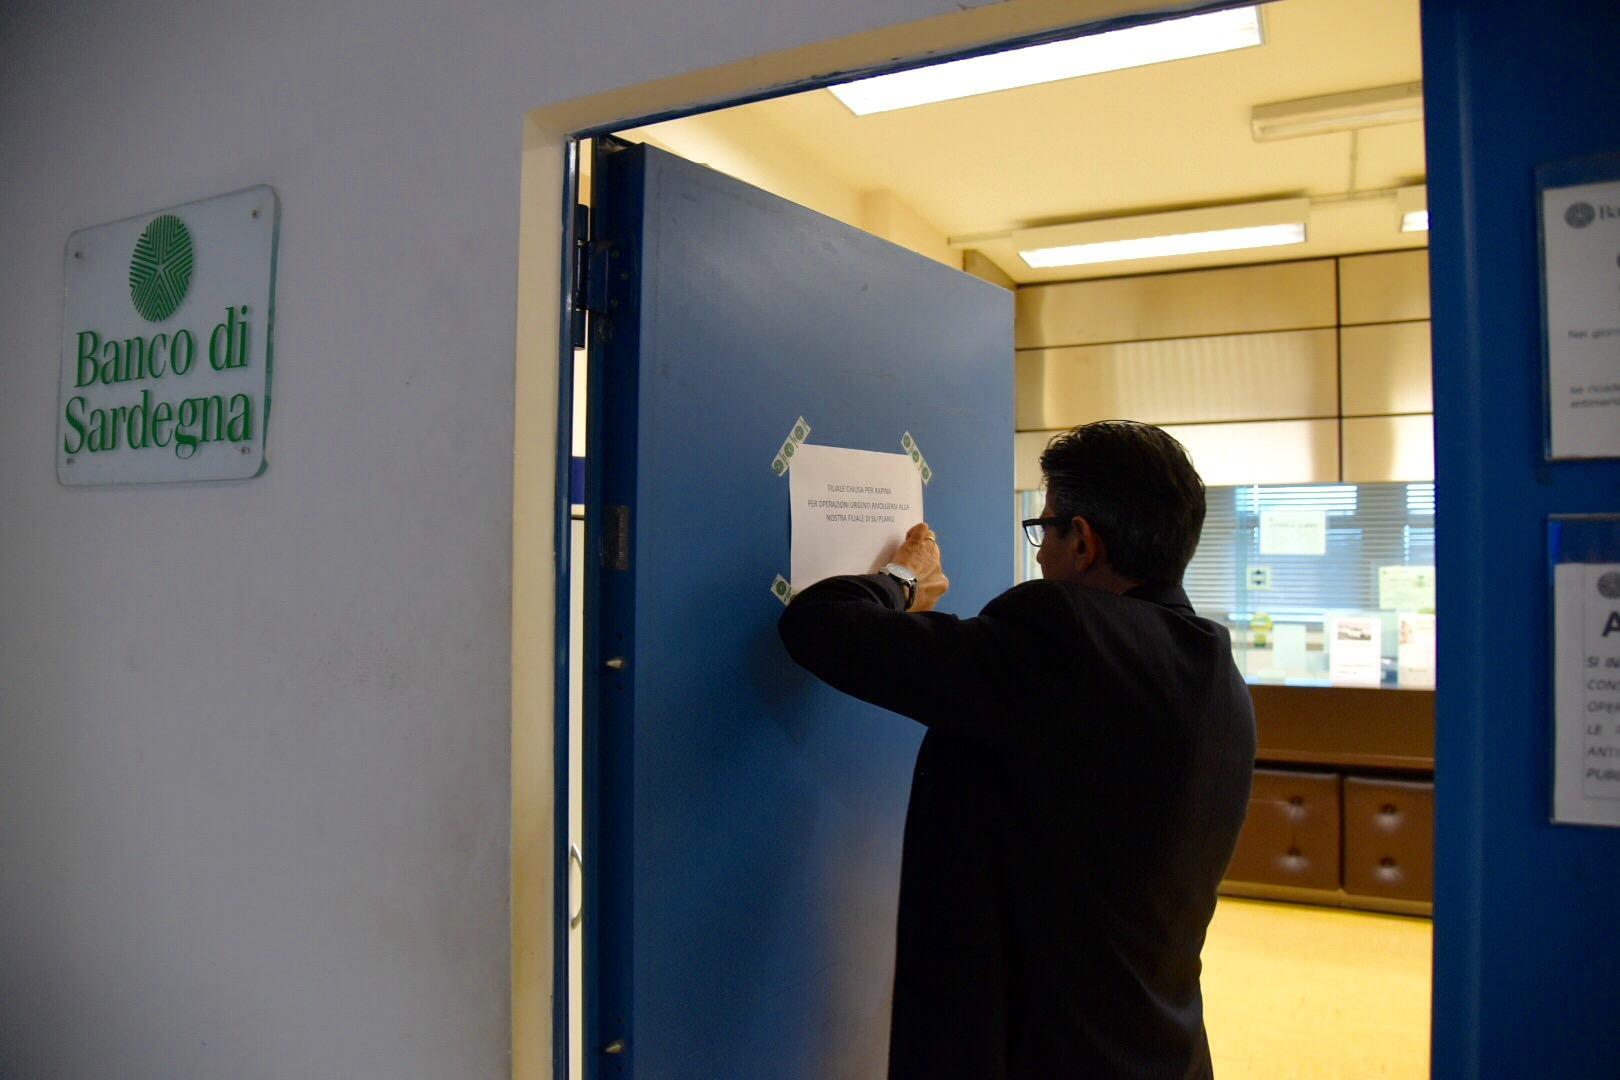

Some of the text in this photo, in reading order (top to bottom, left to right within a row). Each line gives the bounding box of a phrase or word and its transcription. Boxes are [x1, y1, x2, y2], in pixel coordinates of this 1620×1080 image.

[74, 305, 248, 388] Banco di
[64, 389, 254, 460] Sardegna
[827, 484, 892, 495] FILIALE CHIUSA PER RAPINA
[807, 500, 910, 511] PER OPERAZIONI URGENTI RIVOLGERSI ALLA
[826, 514, 847, 522] NOSTRA
[847, 514, 864, 523] FILIALE
[865, 515, 871, 523] DI
[871, 515, 878, 523] SU
